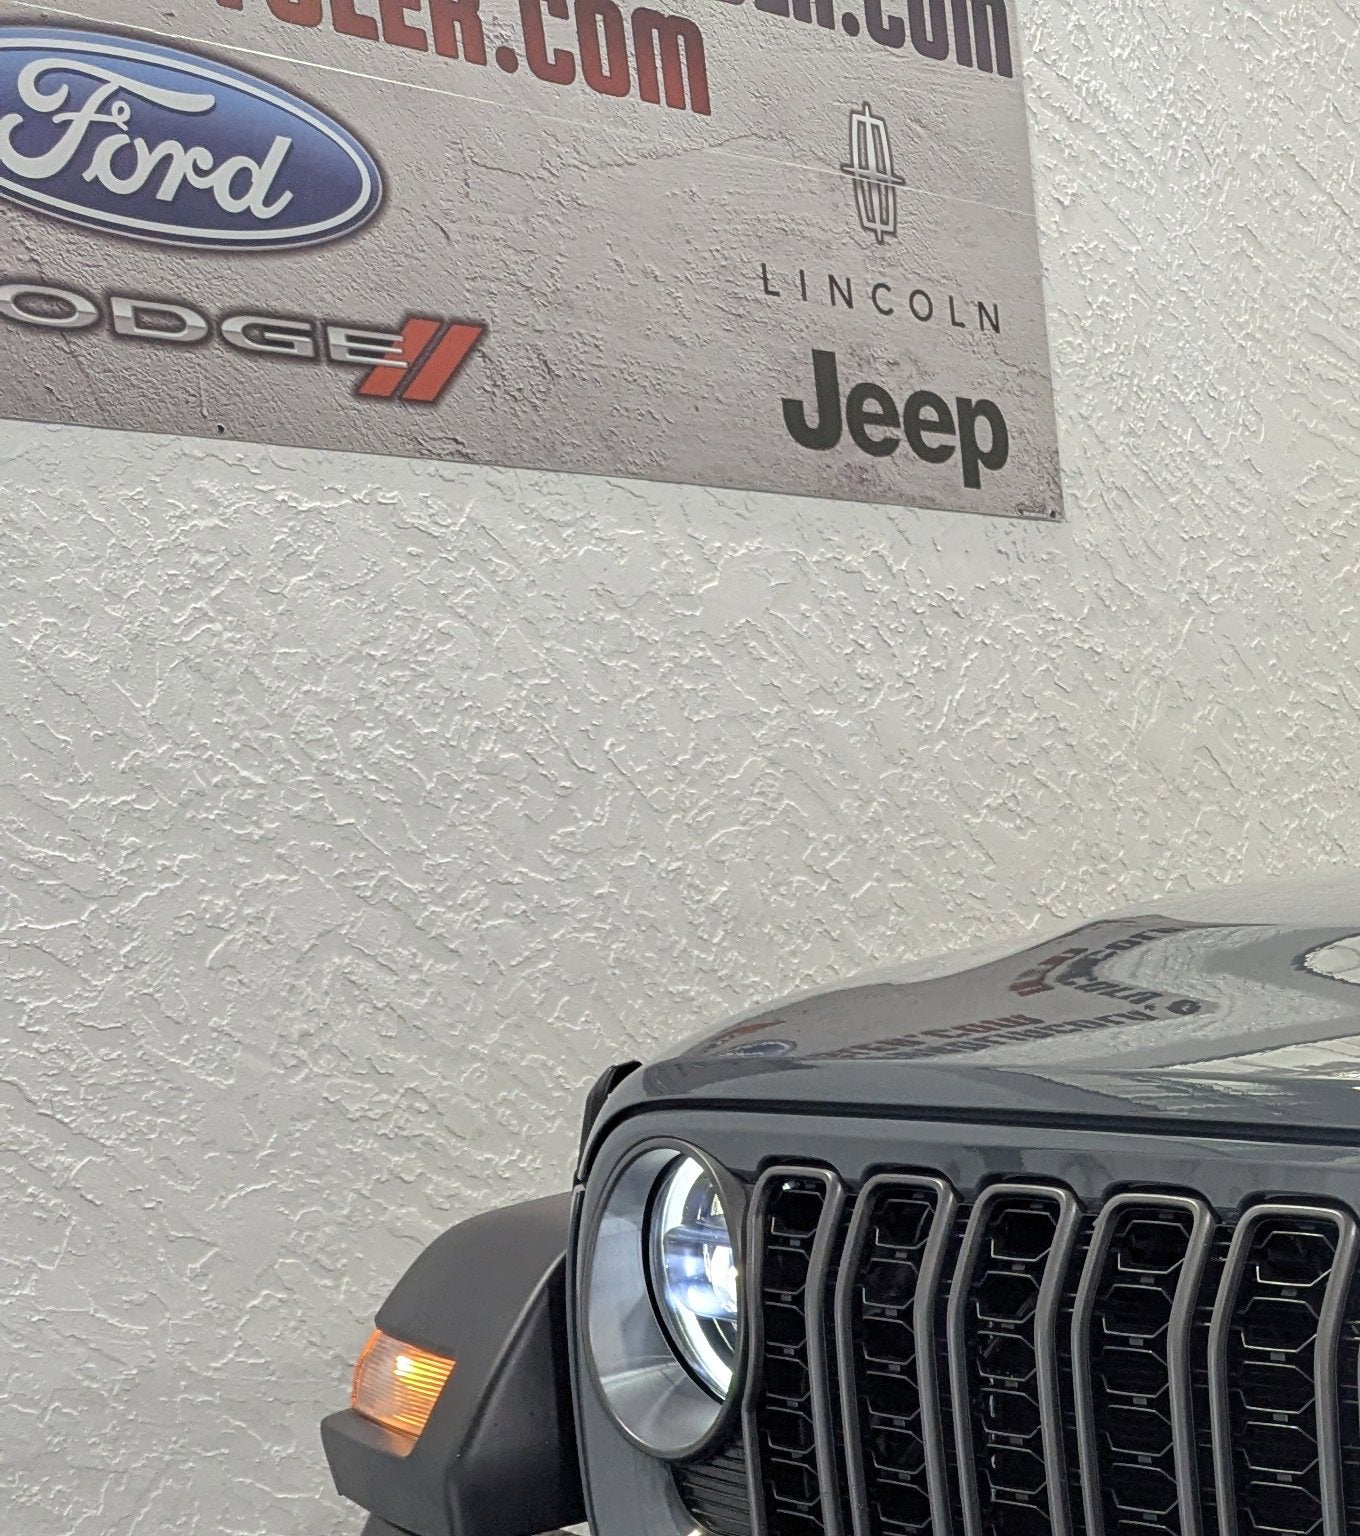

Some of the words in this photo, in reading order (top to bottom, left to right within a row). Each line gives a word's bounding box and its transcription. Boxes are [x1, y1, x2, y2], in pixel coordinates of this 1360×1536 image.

[0, 57, 294, 220] Ford
[760, 262, 1001, 334] LINCOLN
[781, 348, 1010, 490] Jeep
